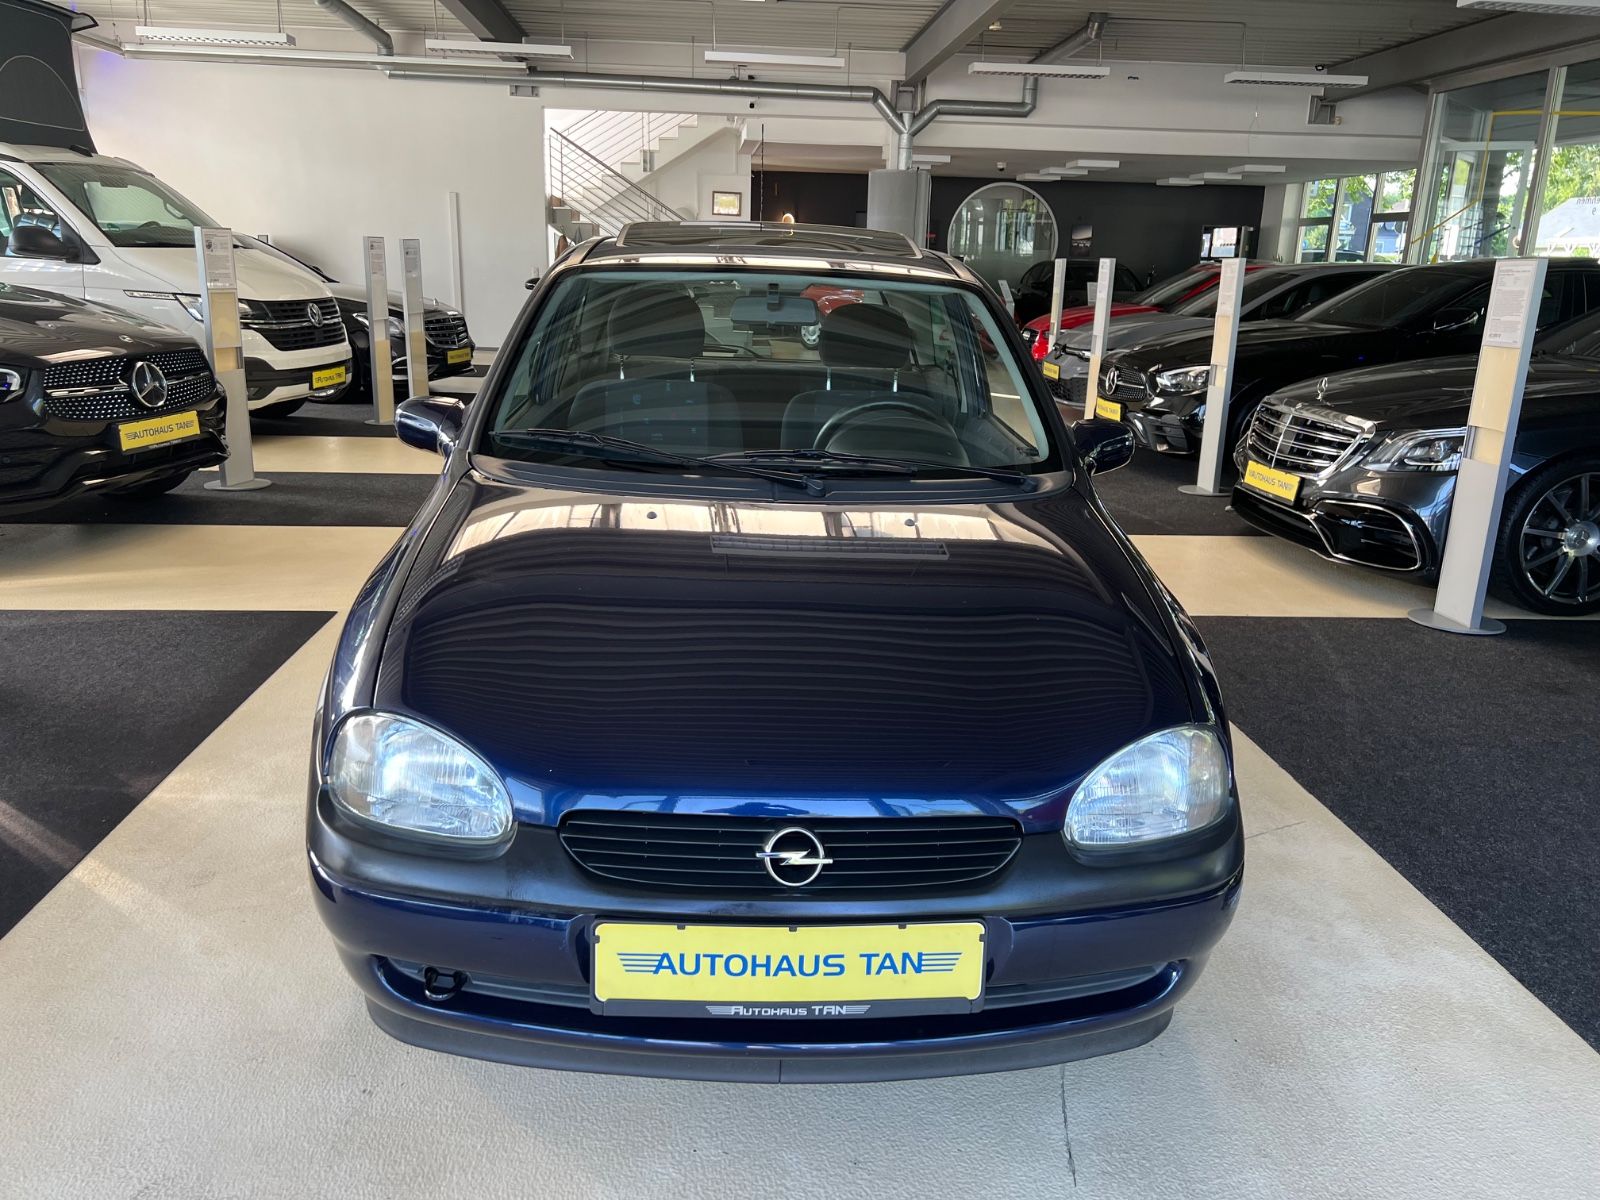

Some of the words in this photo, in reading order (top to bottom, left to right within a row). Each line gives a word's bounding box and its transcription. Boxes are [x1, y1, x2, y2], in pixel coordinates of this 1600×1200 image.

[134, 425, 174, 439] AUTOHAUS
[175, 422, 188, 430] TAN
[1251, 470, 1276, 486] AUTOHAUS
[653, 952, 845, 977] AUTOHAUS
[859, 952, 923, 976] TAN
[731, 1005, 807, 1016] AUTOHAUS
[812, 1005, 846, 1016] TAN
